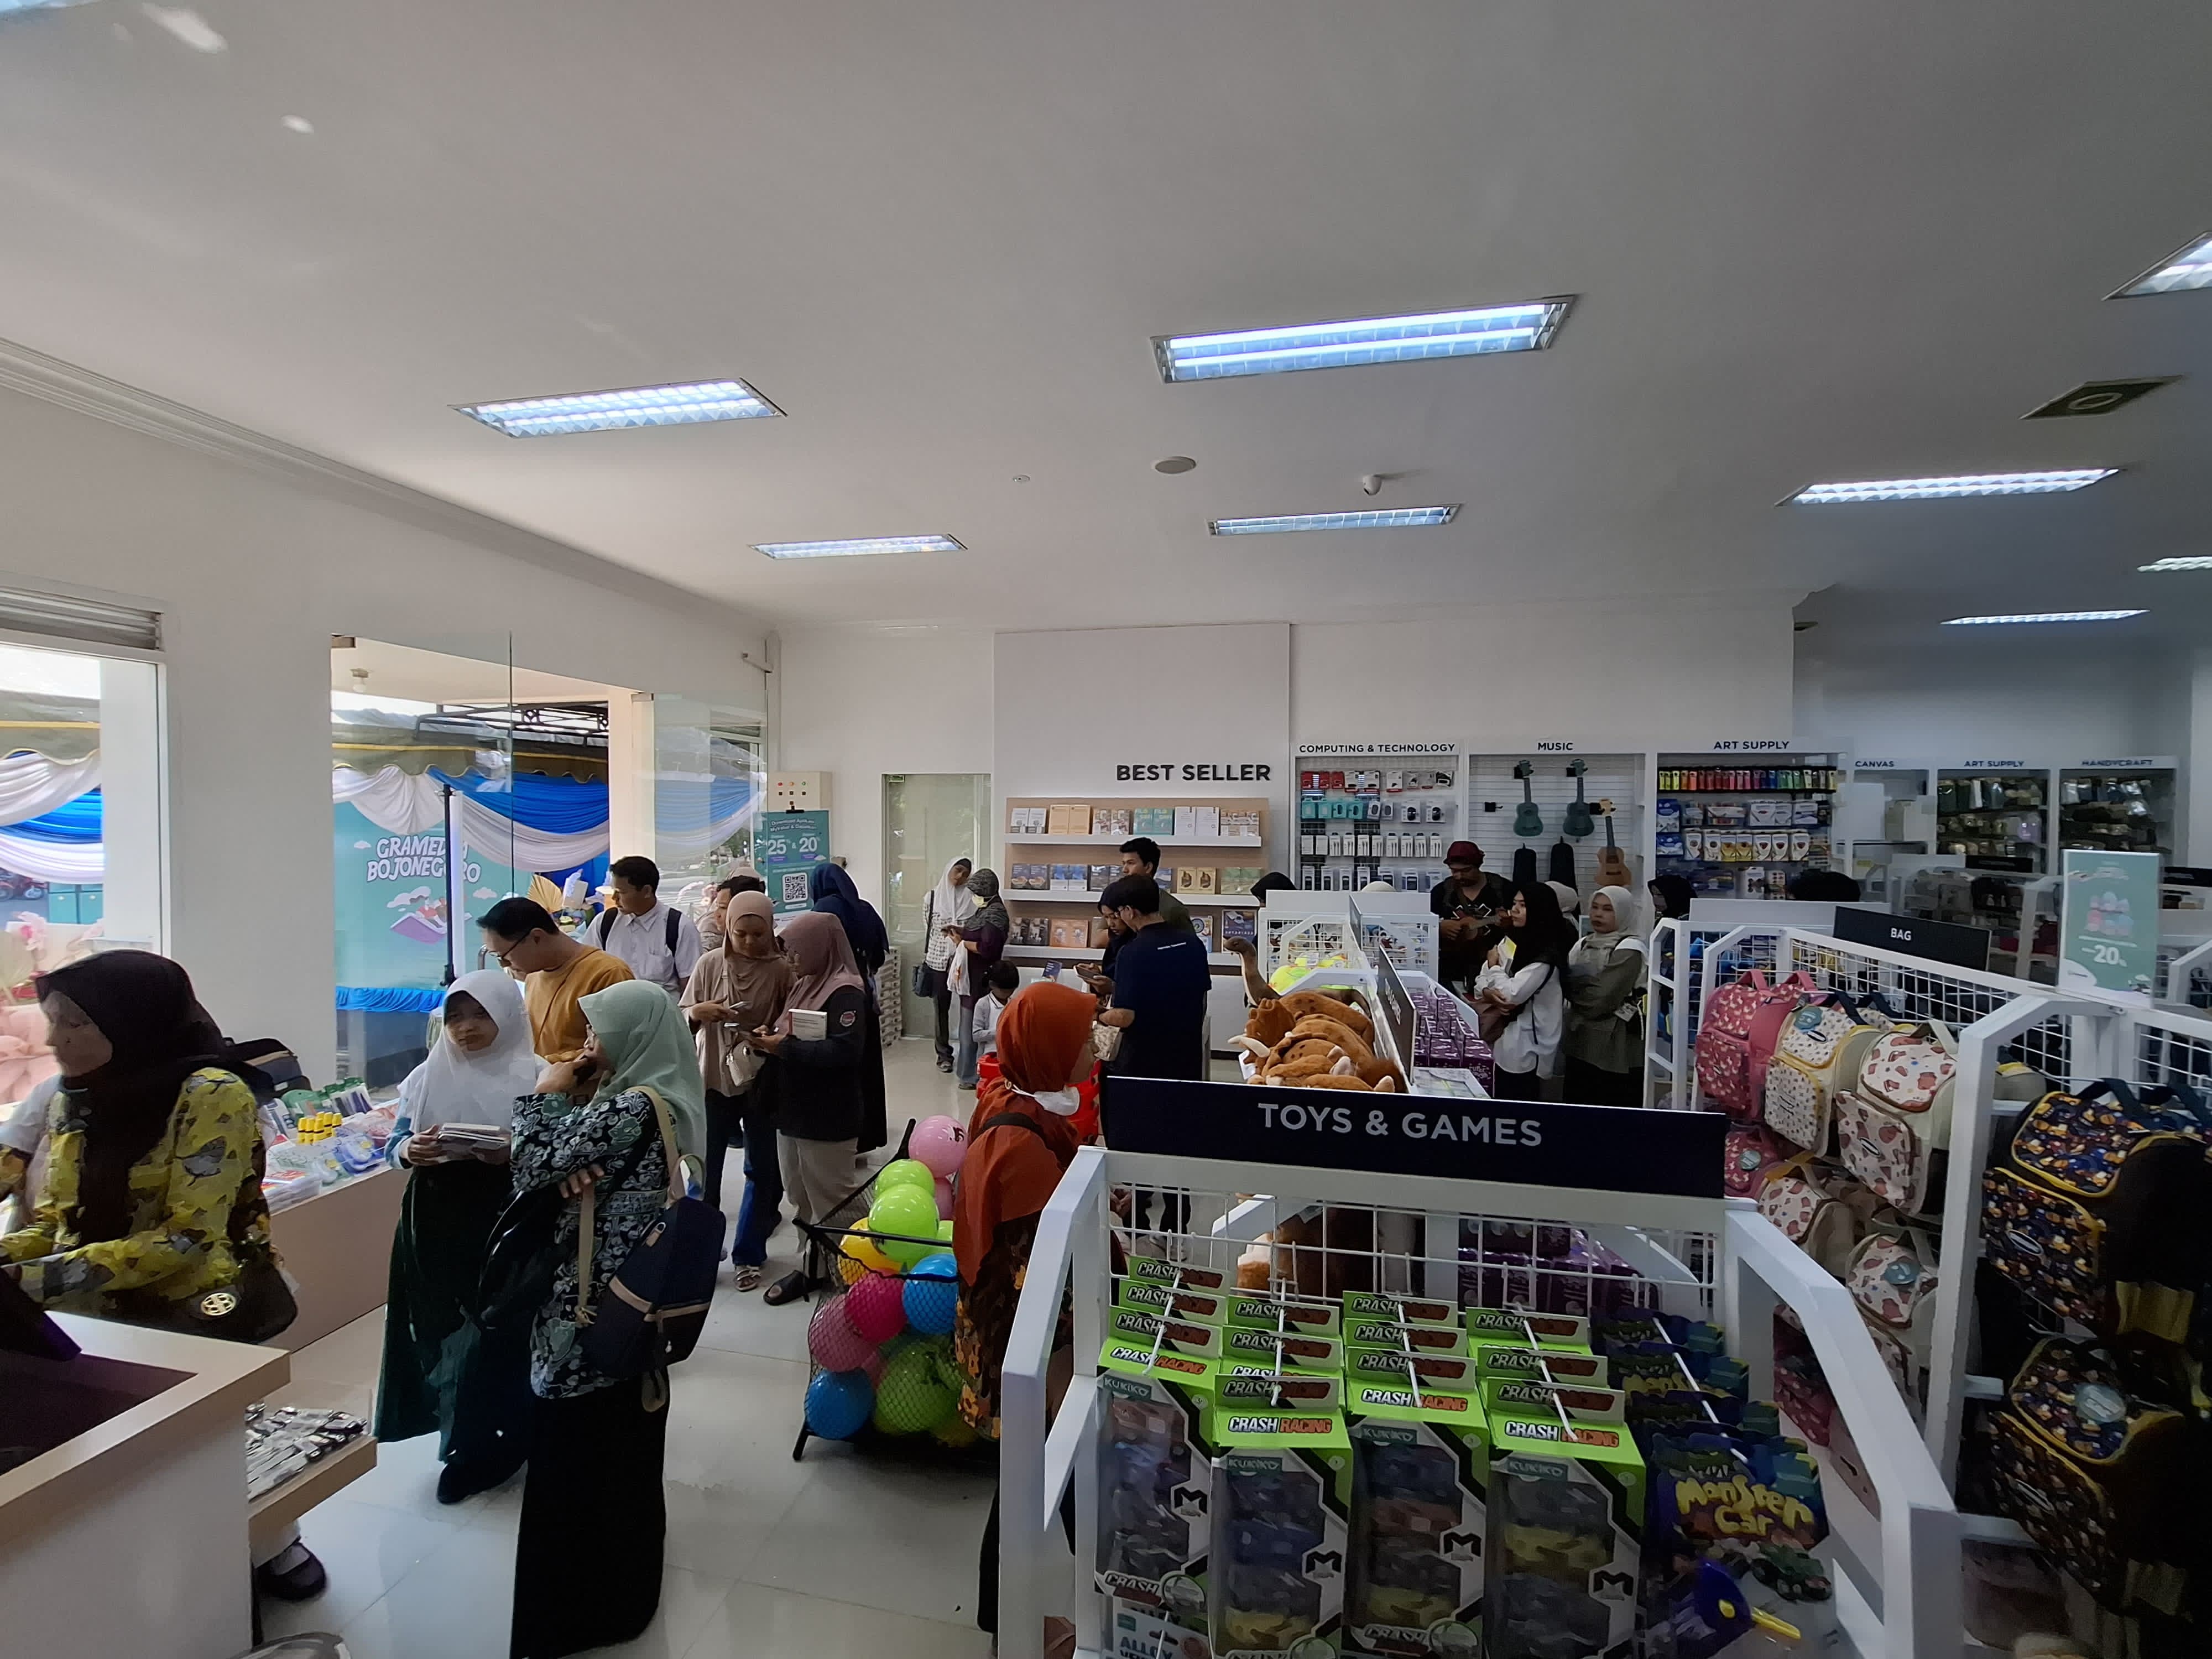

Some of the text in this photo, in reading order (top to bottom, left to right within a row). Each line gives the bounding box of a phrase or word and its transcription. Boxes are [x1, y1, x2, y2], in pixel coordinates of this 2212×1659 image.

[1299, 744, 1455, 753] COMPUTING & TECHNOLOGY
[1538, 742, 1573, 750] MUSIC
[1714, 741, 1790, 750] ART SUPPLY
[1117, 764, 1271, 781] BEST SELLER
[1890, 928, 1912, 942] BAG
[1258, 1103, 1542, 1146] TOYS & GAMES
[1137, 1261, 1179, 1280] CRASH
[1126, 1286, 1171, 1307] CRASH
[1235, 1301, 1282, 1319] CRASH
[1353, 1297, 1399, 1315] CRASH
[1115, 1313, 1163, 1335] CRASH
[1475, 1313, 1526, 1332] CRASH
[1231, 1333, 1281, 1351] CRASH
[1355, 1325, 1405, 1344] CRASH
[1357, 1354, 1410, 1374] CRASH
[1486, 1352, 1542, 1371] CRASH
[1104, 1377, 1149, 1396] KUKIKO
[1223, 1380, 1276, 1397] CRASH
[1498, 1384, 1555, 1405] CRASH
[1362, 1389, 1412, 1406] CRASH
[1228, 1417, 1332, 1433] CRASH RACING
[1504, 1420, 1559, 1441] CRASH
[1363, 1428, 1413, 1442] KUKIKO
[1229, 1458, 1279, 1470] KUKIKO
[1510, 1461, 1563, 1478] KUKIKO
[1714, 1505, 1775, 1536] Car
[1105, 1573, 1159, 1595] CRASH
